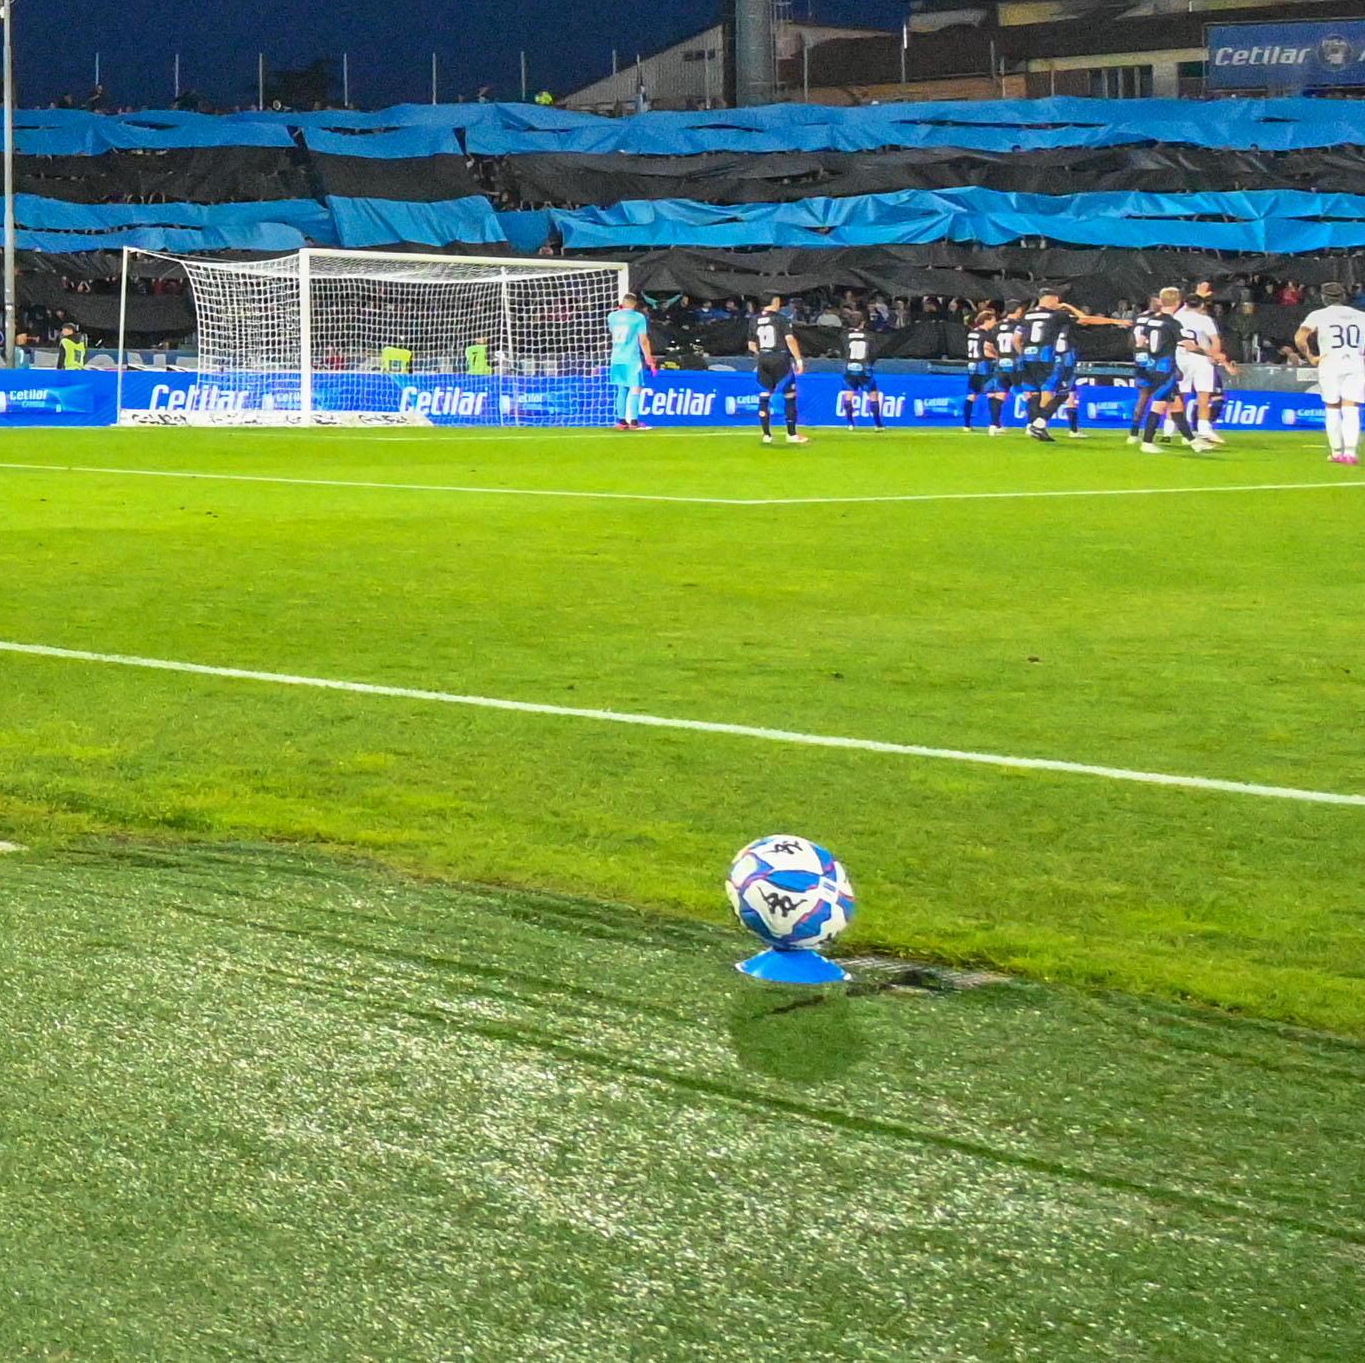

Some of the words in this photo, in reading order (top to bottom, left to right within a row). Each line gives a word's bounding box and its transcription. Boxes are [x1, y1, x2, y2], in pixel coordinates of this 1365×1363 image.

[1215, 46, 1311, 66] Cetilar
[1329, 324, 1360, 348] 30
[9, 389, 48, 400] Cetilar
[149, 384, 250, 411] Cetilar
[400, 386, 488, 415] Cetilar
[639, 388, 717, 416] Cetilar
[836, 390, 906, 418] Cetlar
